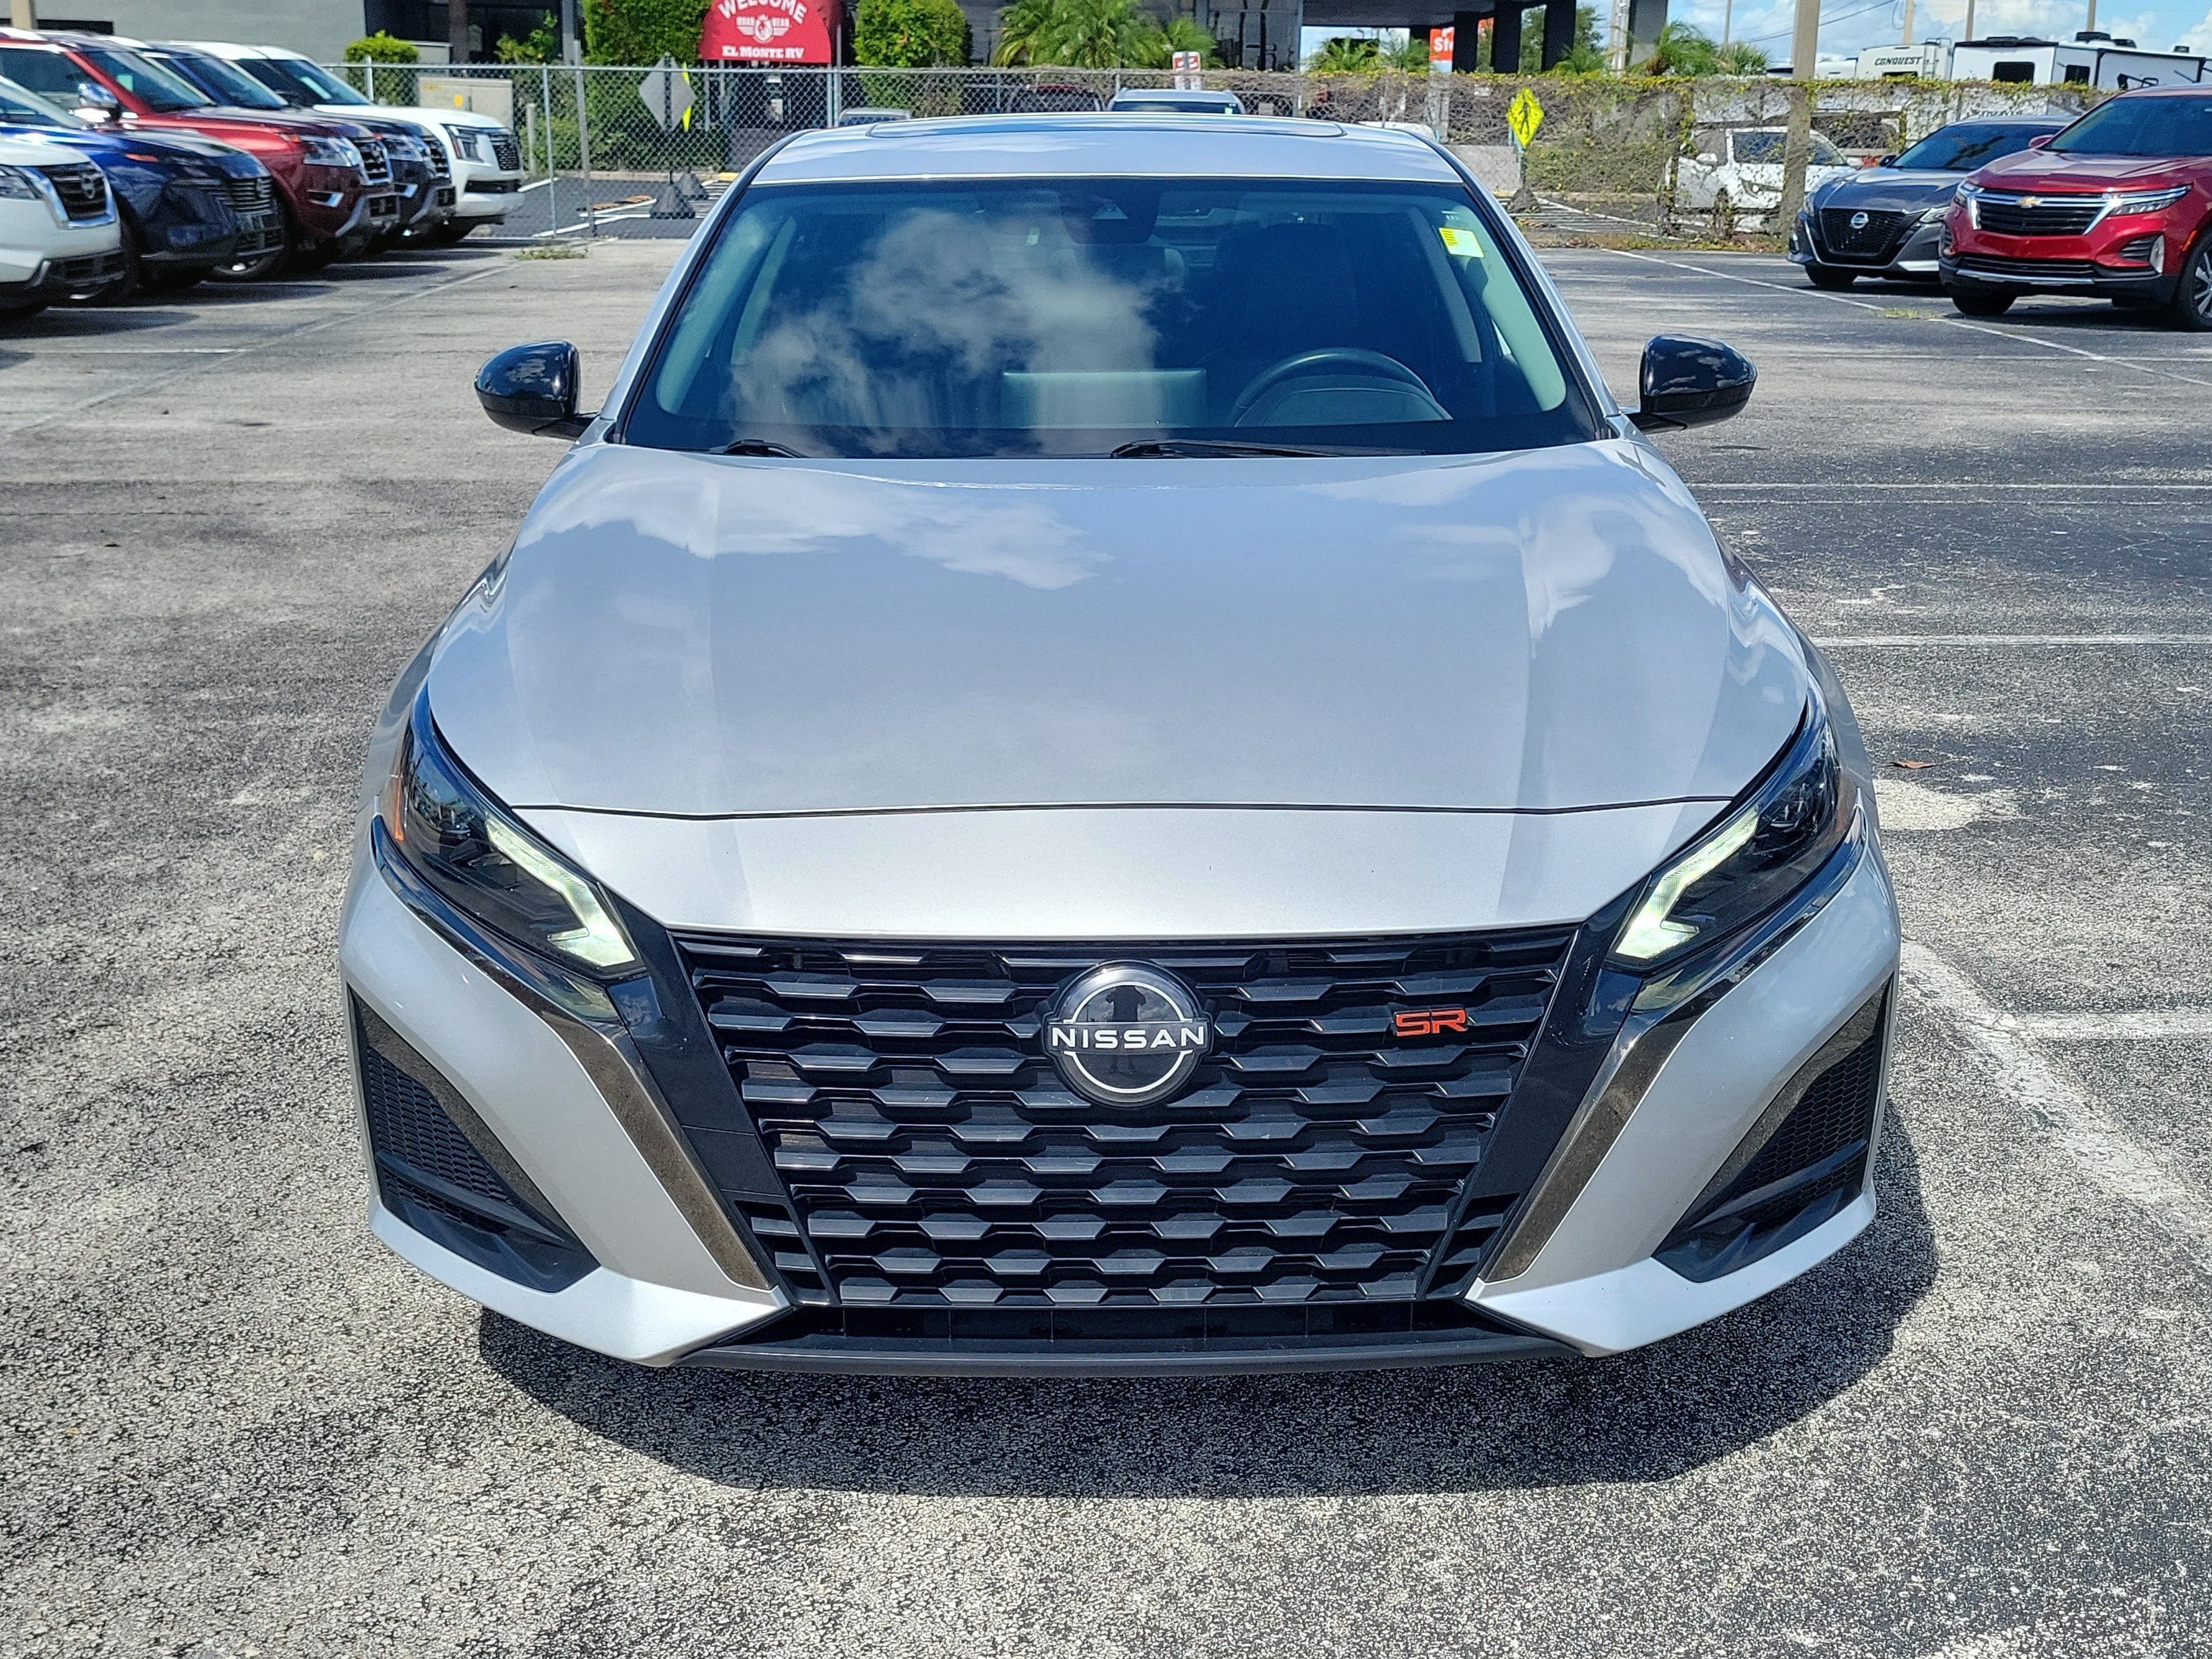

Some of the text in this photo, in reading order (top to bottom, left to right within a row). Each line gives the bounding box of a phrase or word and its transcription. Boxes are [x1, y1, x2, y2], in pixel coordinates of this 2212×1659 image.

[722, 46, 738, 57] EL
[739, 47, 783, 58] MONTE
[1874, 57, 1922, 66] CONQUEST
[1396, 1009, 1466, 1036] SR
[1052, 1026, 1204, 1049] NISSAN
